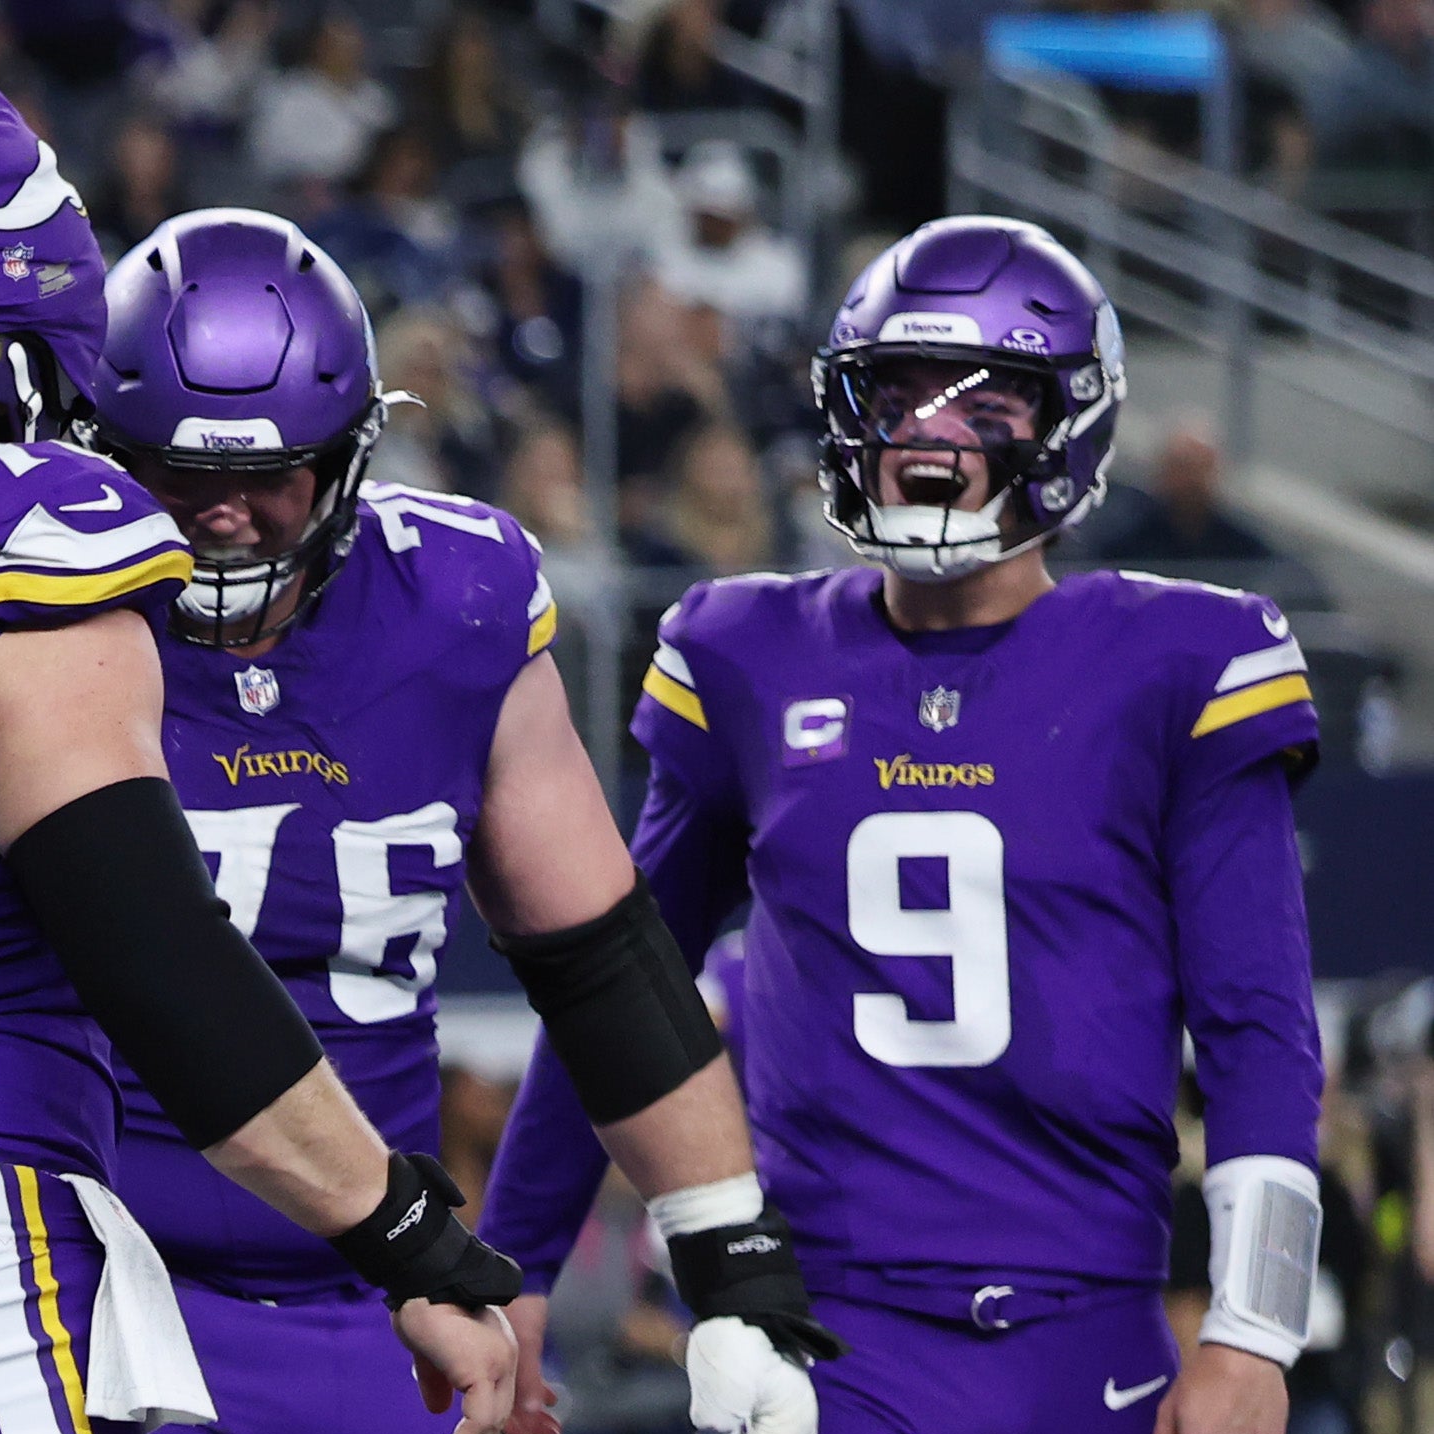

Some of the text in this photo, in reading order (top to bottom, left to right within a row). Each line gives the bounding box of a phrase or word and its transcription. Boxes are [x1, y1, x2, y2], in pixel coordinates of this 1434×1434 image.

[785, 698, 847, 750] C
[212, 743, 350, 786] VIKINGS
[873, 753, 995, 790] VIKINGS
[846, 811, 1012, 1067] 9
